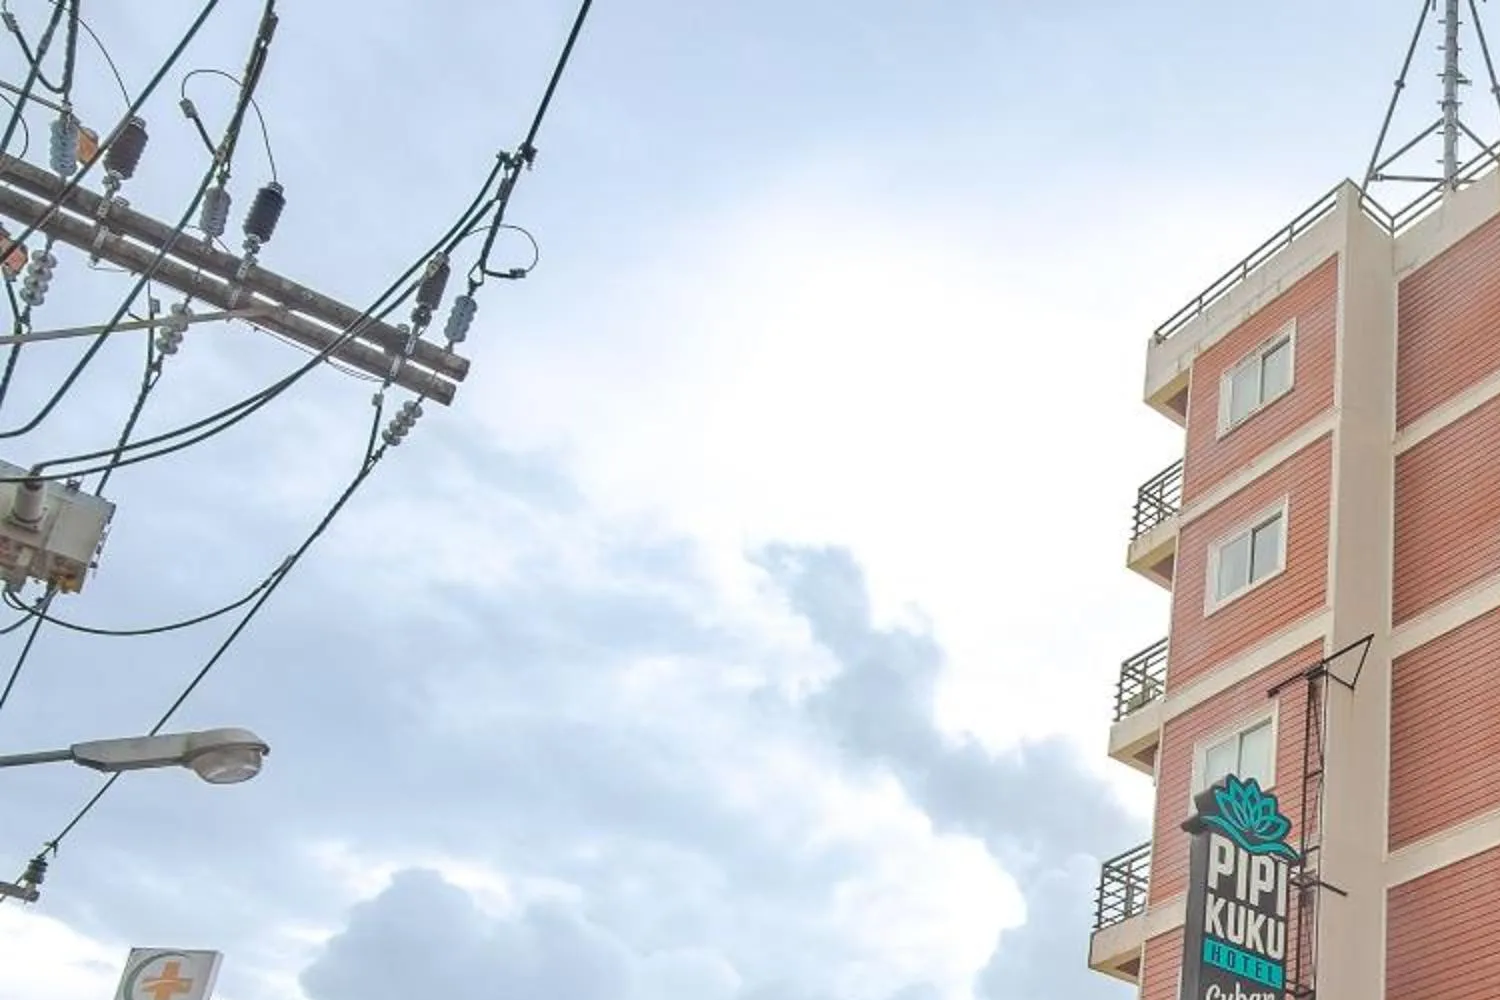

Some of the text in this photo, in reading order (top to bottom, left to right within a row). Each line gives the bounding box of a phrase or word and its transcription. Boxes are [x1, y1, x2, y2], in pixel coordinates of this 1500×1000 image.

[1208, 832, 1288, 917] PIPI
[1205, 892, 1285, 960] KUKU
[1211, 944, 1276, 983] HOTEL
